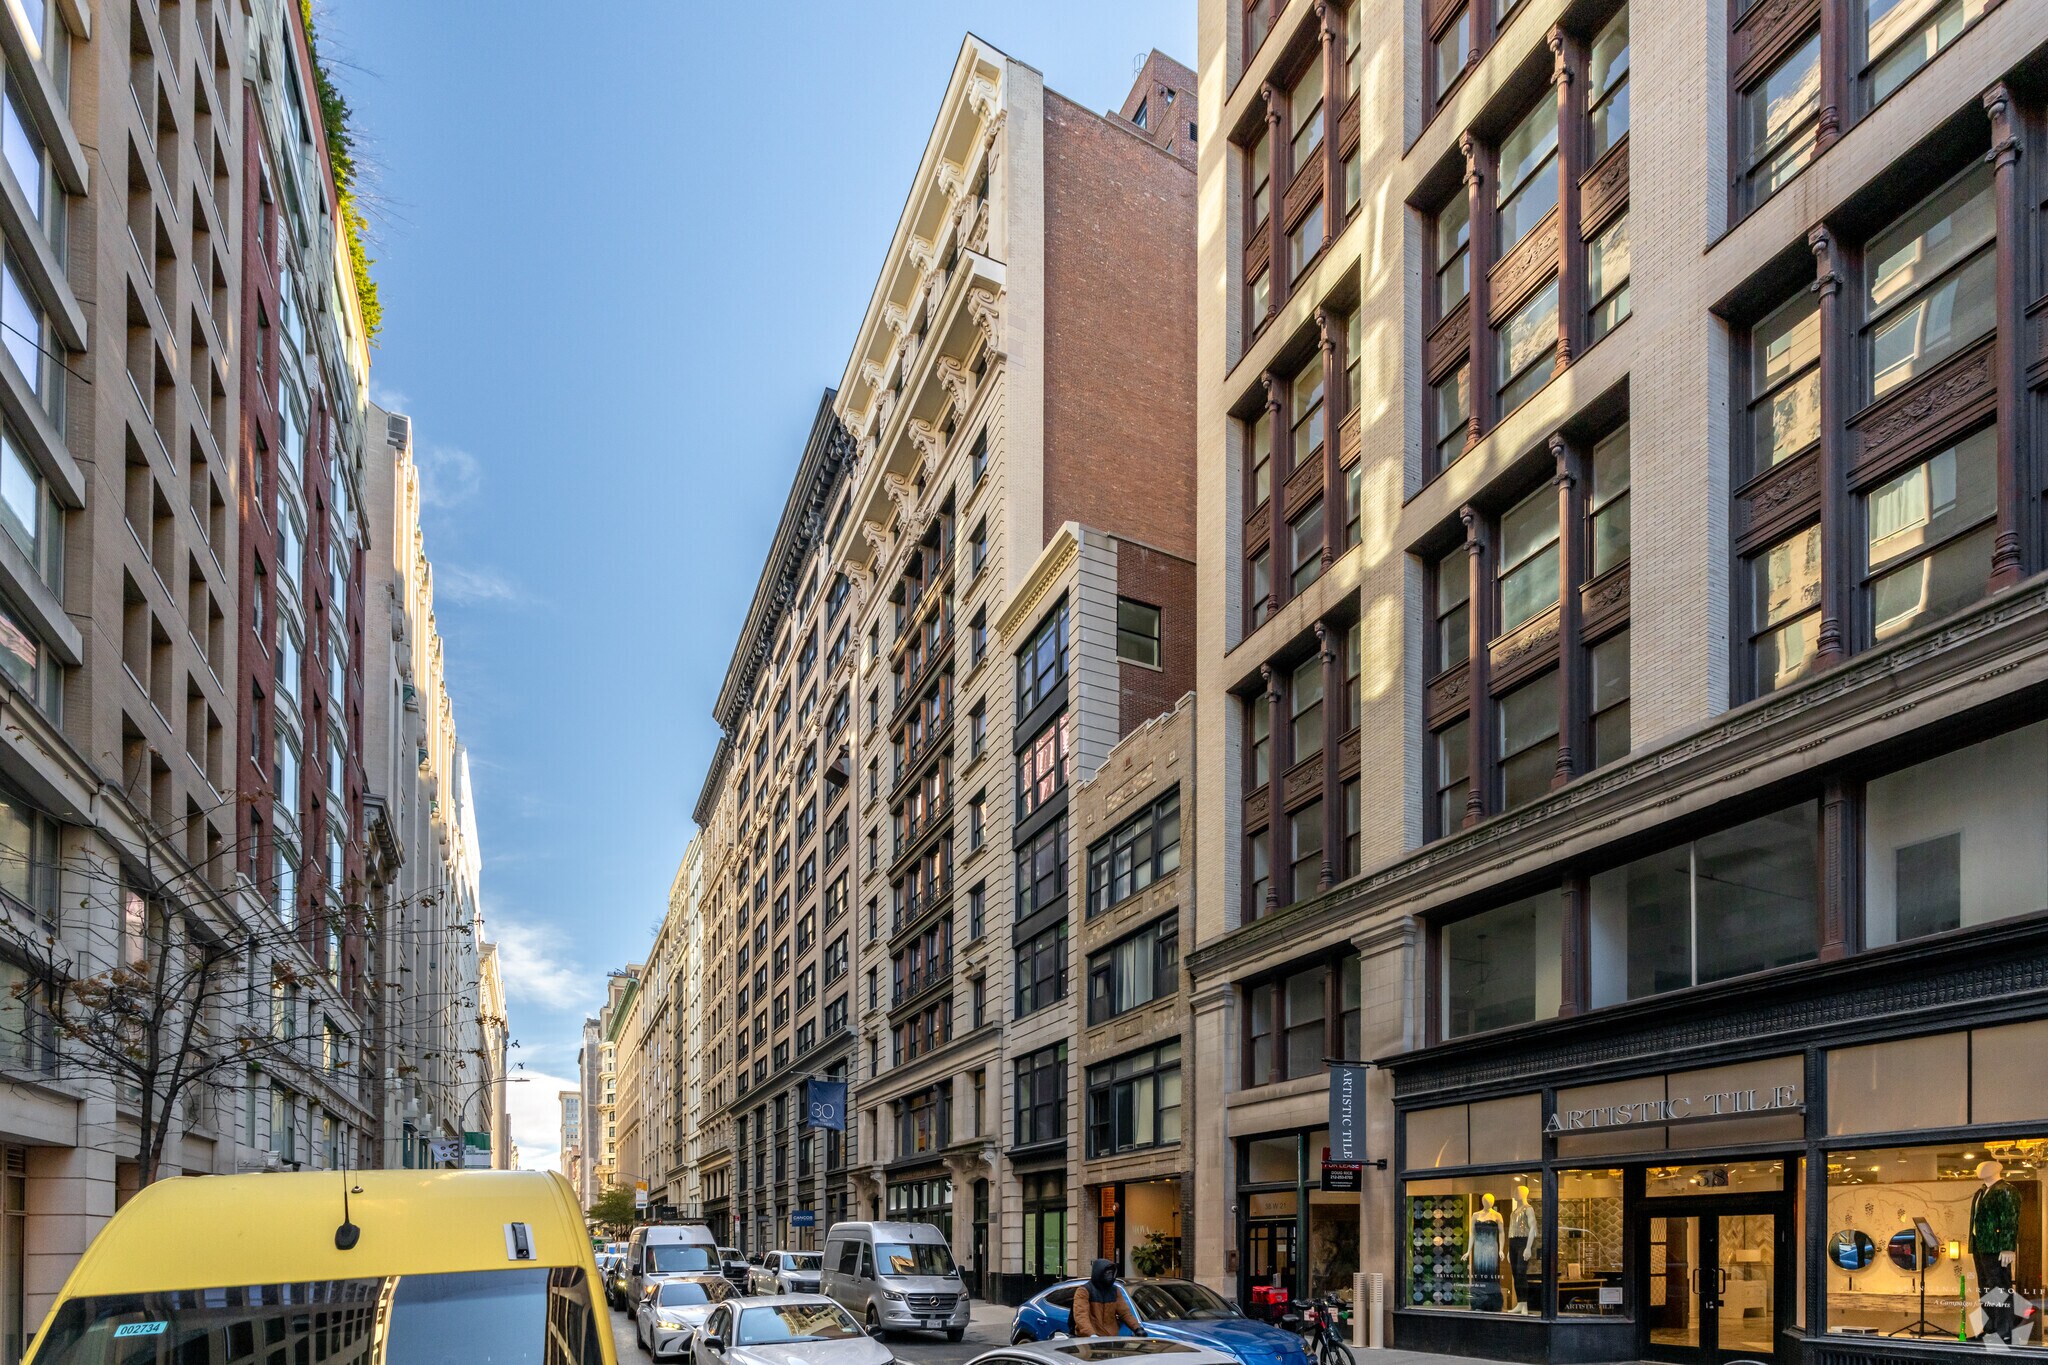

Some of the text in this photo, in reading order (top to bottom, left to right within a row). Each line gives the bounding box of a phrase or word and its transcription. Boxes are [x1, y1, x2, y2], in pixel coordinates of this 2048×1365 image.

[811, 1102, 835, 1119] 30
[1342, 1068, 1353, 1159] ARTISTIC TILE
[1543, 1085, 1799, 1133] ARTISTIC TILE
[1968, 1286, 1991, 1294] ART
[1939, 1300, 1973, 1308] Campaign
[120, 1323, 161, 1335] 002734
